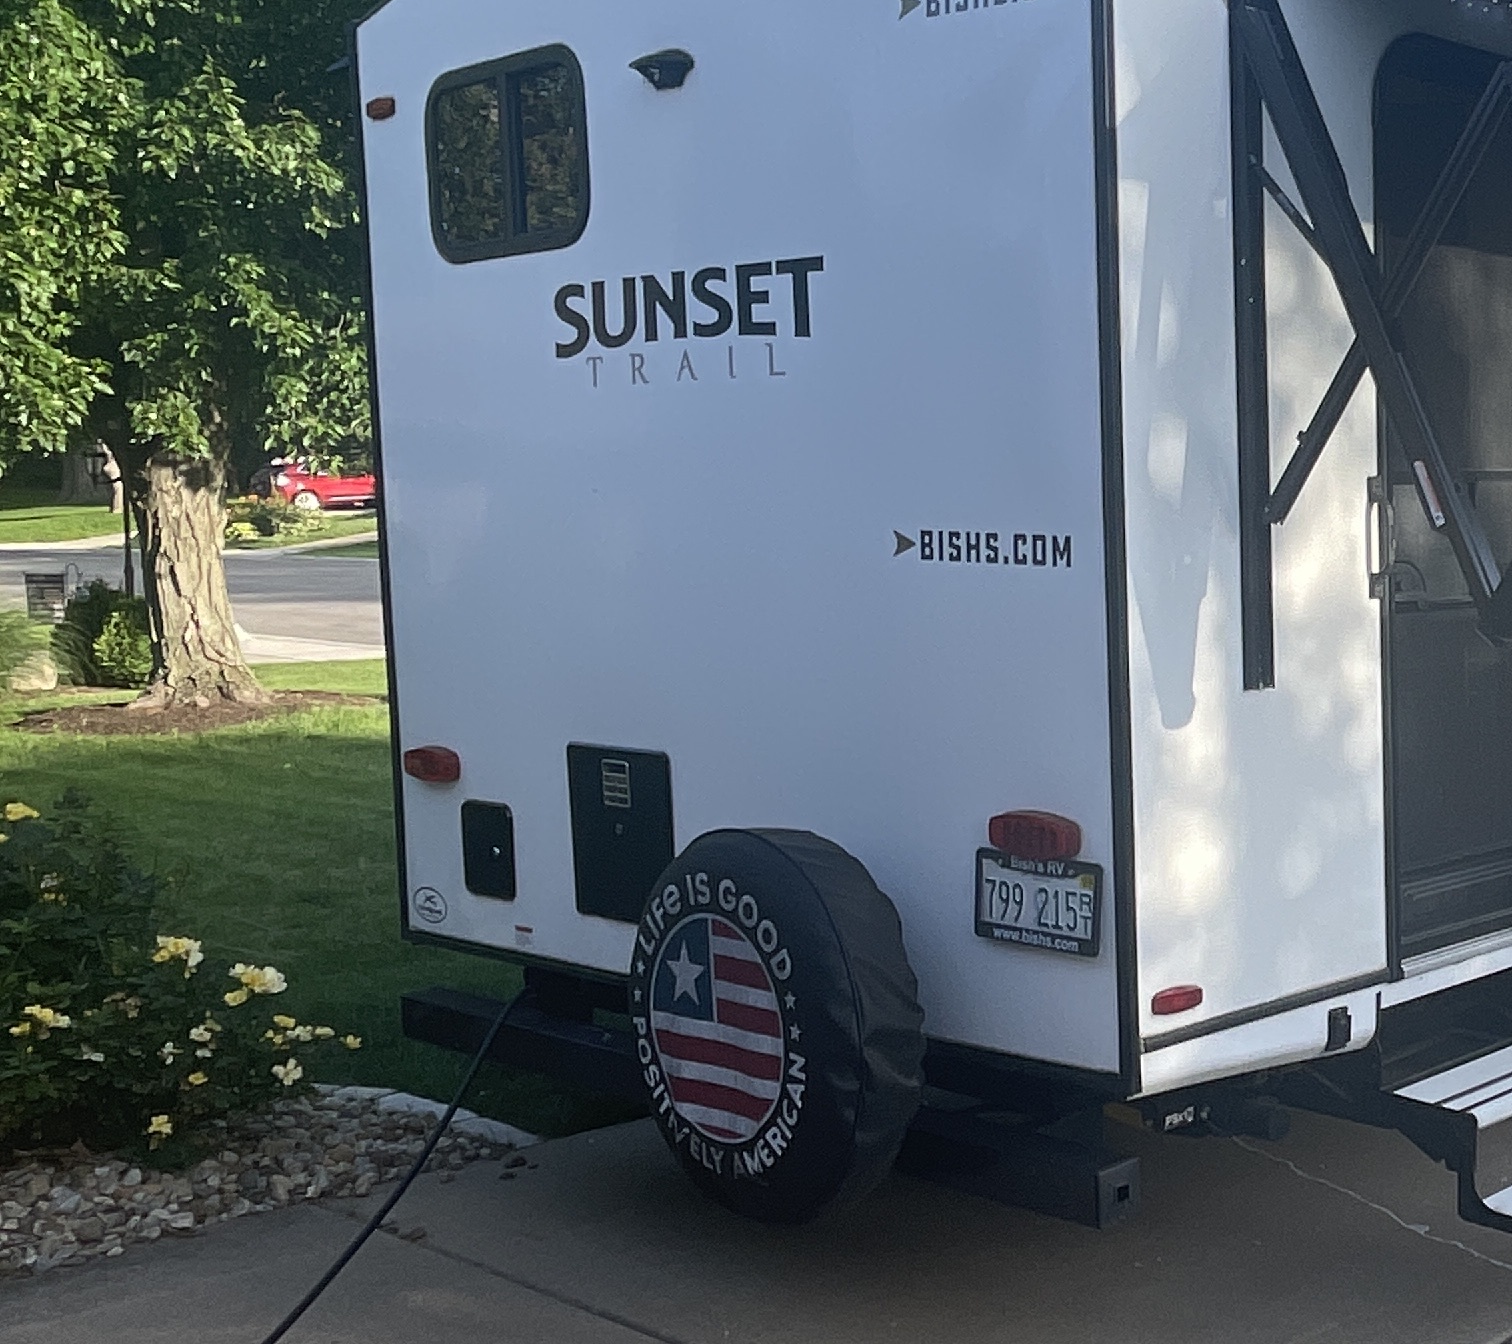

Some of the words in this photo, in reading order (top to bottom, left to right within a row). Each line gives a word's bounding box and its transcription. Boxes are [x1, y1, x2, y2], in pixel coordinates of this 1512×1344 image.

[554, 255, 824, 359] SUNSET
[586, 342, 786, 388] TRAIL
[920, 530, 1072, 567] BISHS.COM
[1046, 861, 1065, 875] RV
[685, 872, 711, 906] IS
[718, 878, 792, 980] GOOD
[985, 877, 1024, 923] 799
[1036, 887, 1078, 932] 215
[993, 927, 1079, 952] www.bishs.com
[632, 1016, 725, 1175] POSITIVELY
[732, 1052, 807, 1179] AMERICAN
